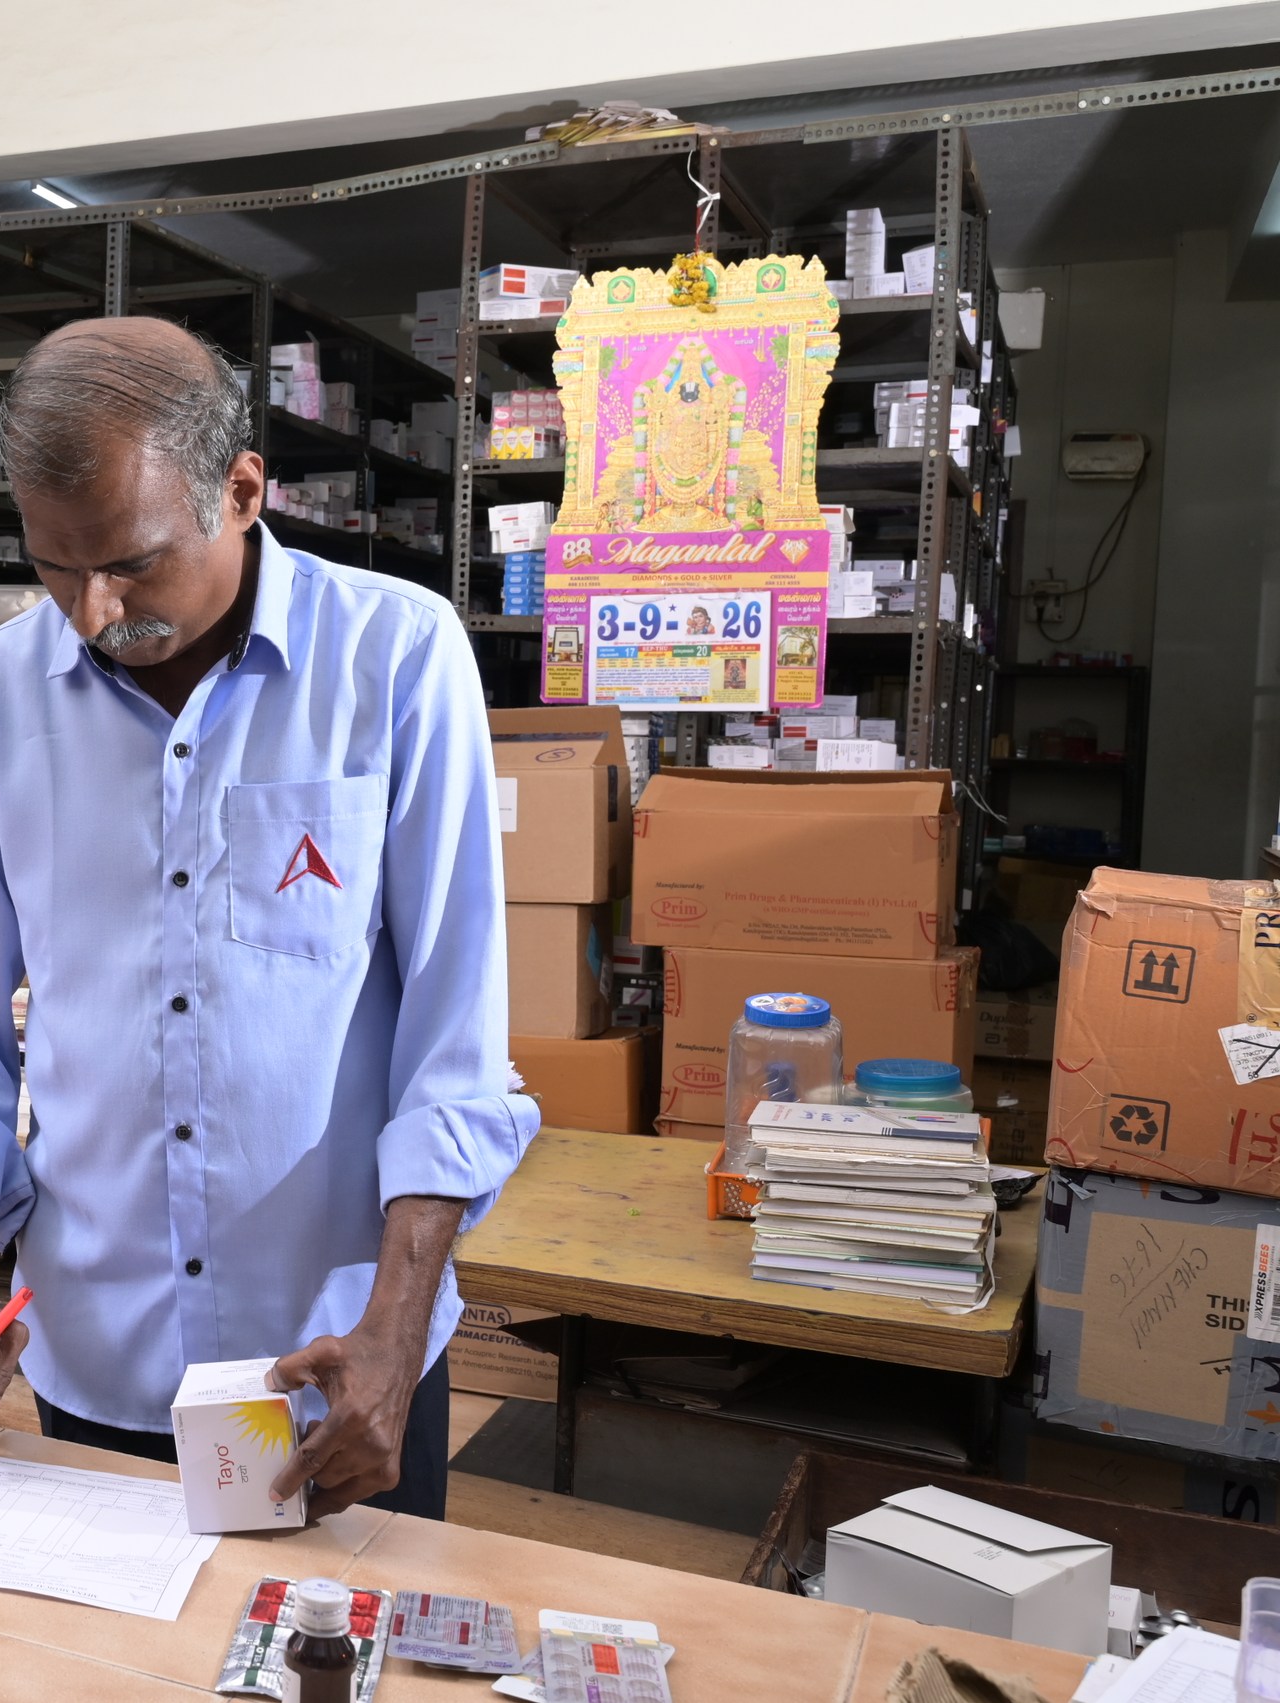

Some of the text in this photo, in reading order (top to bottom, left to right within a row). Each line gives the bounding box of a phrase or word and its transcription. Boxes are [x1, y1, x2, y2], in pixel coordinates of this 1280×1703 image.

[562, 538, 592, 561] 88
[599, 532, 777, 572] Maganlal
[722, 601, 761, 639] 26
[625, 648, 635, 657] 17
[696, 646, 708, 657] 20
[655, 882, 693, 890] Manufactured
[724, 891, 746, 901] Prim
[749, 892, 776, 903] Drugs
[790, 894, 865, 906] Pharmaceuticals
[661, 900, 698, 915] Prim
[675, 1042, 716, 1052] Manufactured
[683, 1066, 720, 1082] Prim
[1254, 1243, 1270, 1314] XPRESSBEES
[462, 1307, 506, 1325] INTAS
[452, 1329, 524, 1347] RMACEUTIC
[461, 1359, 503, 1372] Ahmedabad
[498, 1352, 532, 1364] Research
[217, 1445, 235, 1490] Tayo
